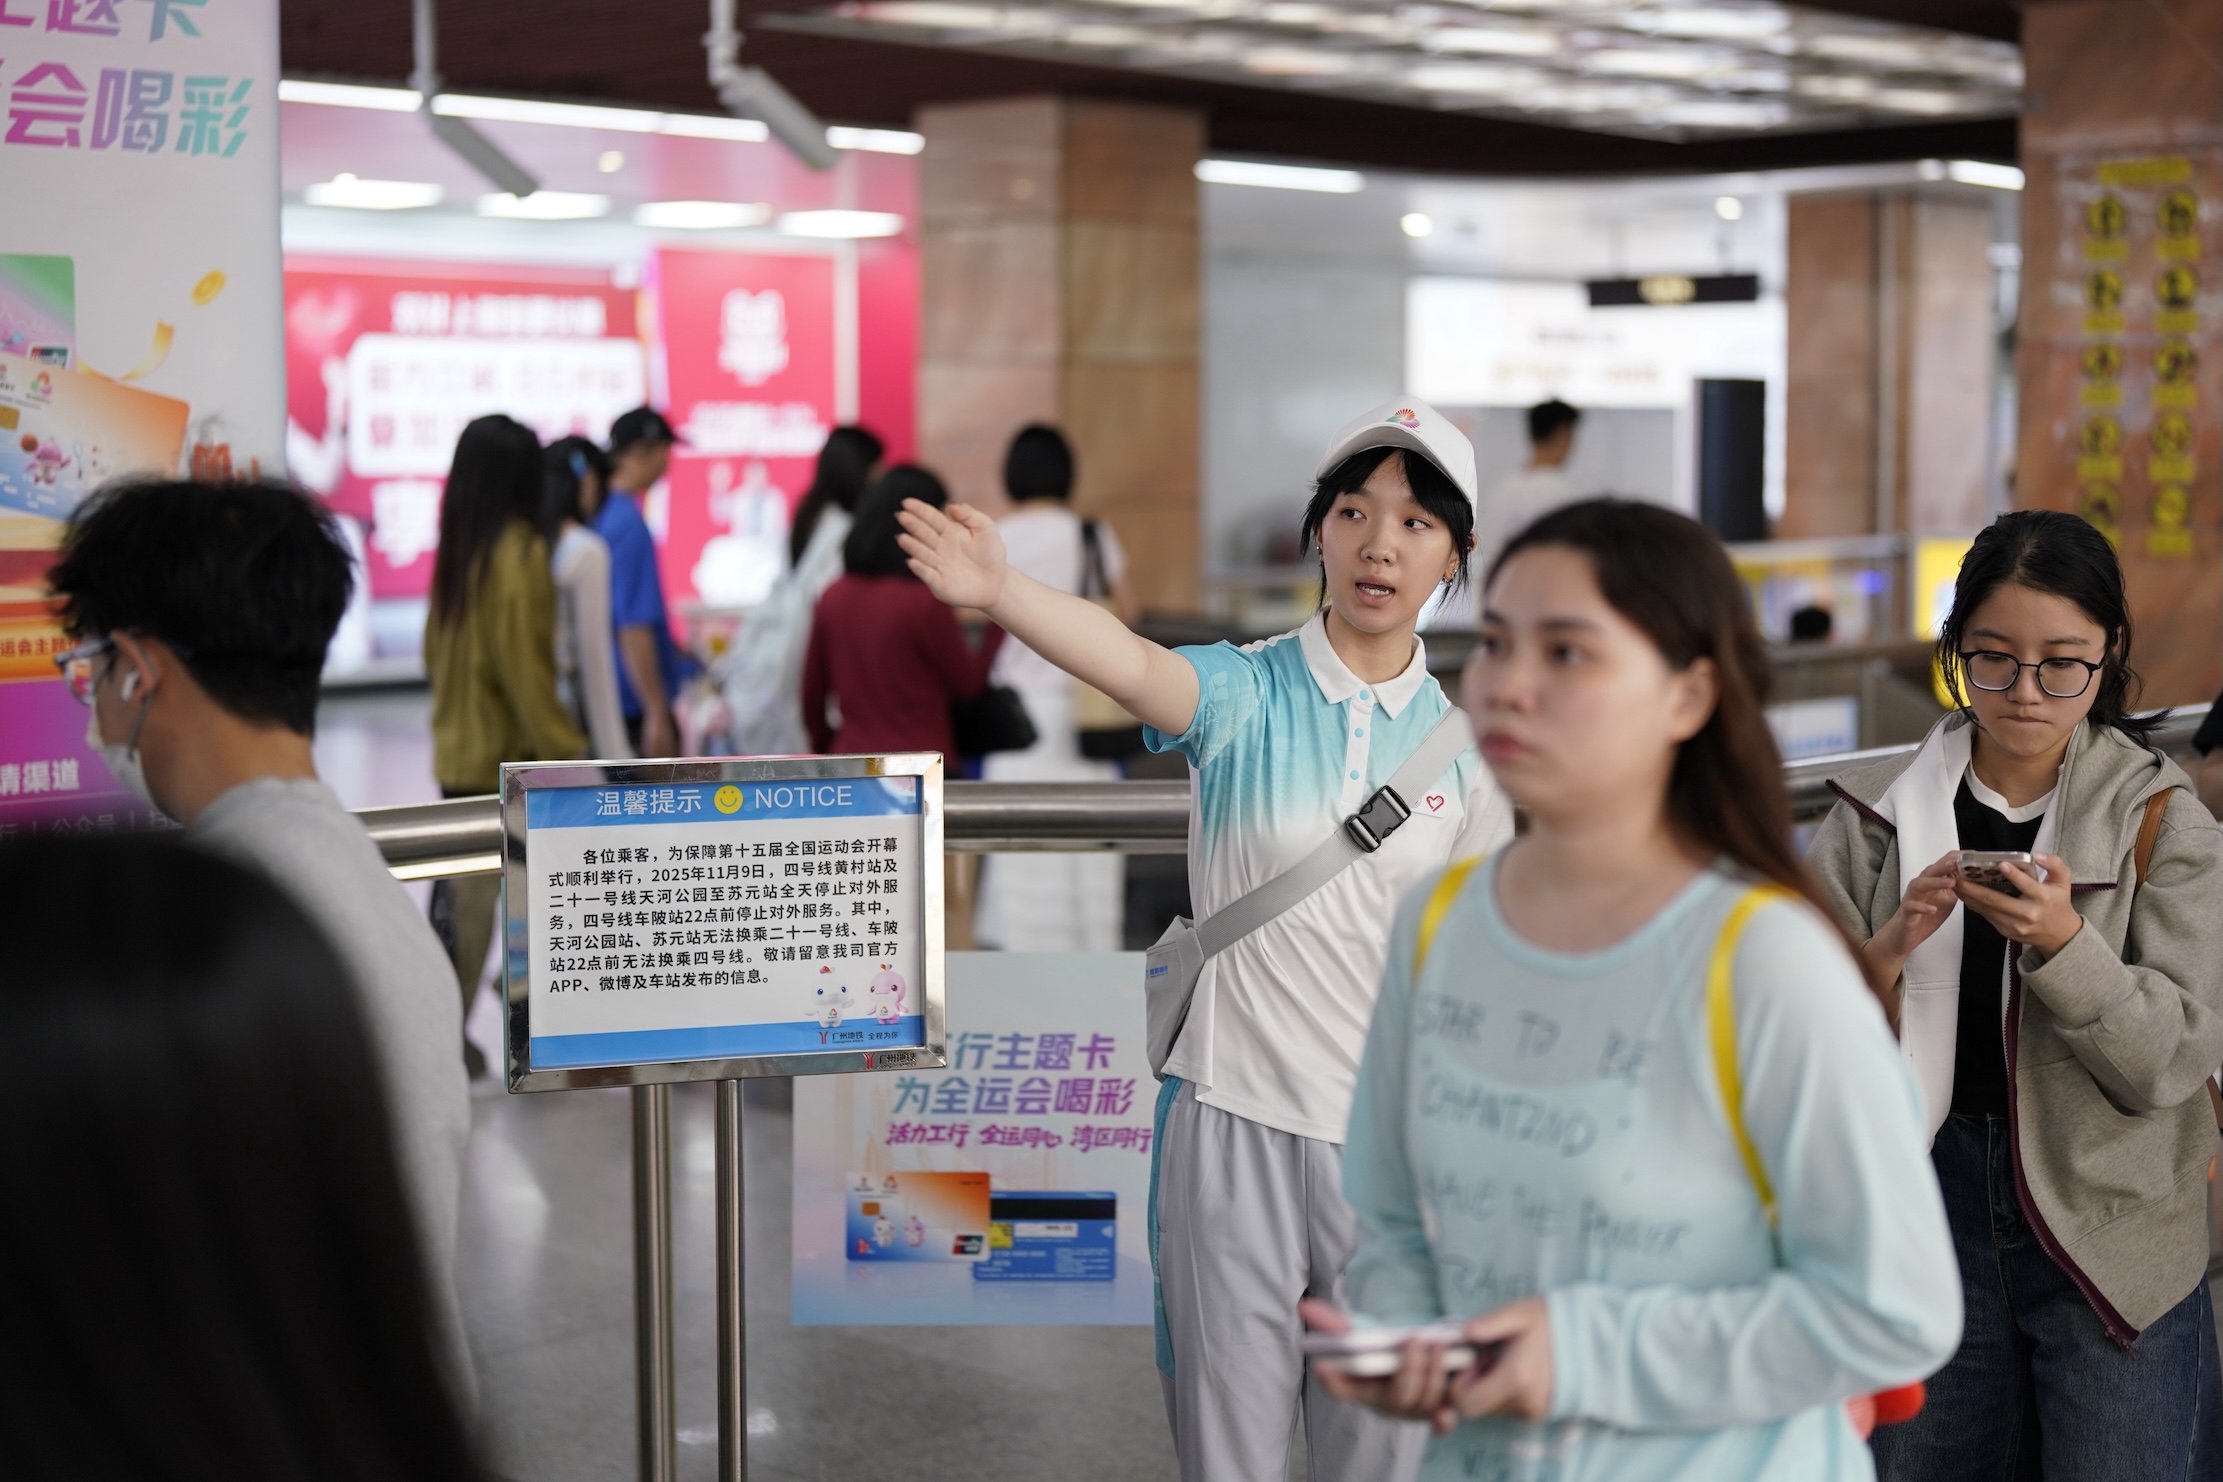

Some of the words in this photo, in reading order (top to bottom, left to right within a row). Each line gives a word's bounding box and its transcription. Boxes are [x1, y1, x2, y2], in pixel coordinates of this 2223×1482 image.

[0, 58, 254, 158] 会喝彩
[596, 789, 702, 816] 温馨提示
[755, 785, 853, 809] NOTICE
[583, 837, 898, 865] 各位乘客，为保障第十五届全国运动会开幕
[549, 858, 898, 887] 式顺利举行，2025年11月9日，四号线黄村站及
[549, 879, 898, 908] 二十一号线天河公园至苏元站全天停止对外服
[549, 900, 892, 930] 务，四号线车陂站22点前停止对外服务。其中，
[549, 920, 898, 951] 天河公园站、苏元站无法换乘二十一号线、车陂
[549, 941, 898, 973] 站22点前无法换乘四号线。敬请留意我司官方
[549, 969, 769, 993] APP、微博及车站发布的信息。
[832, 1031, 864, 1040] 广州地铁
[868, 1031, 899, 1040] 全程为你
[944, 1032, 1115, 1071] 行主题卡
[892, 1075, 1136, 1116] 为全运会喝彩
[885, 1121, 970, 1150] 活力工行
[978, 1123, 1063, 1149] 全运同心
[1069, 1124, 1152, 1154] 湾区同行
